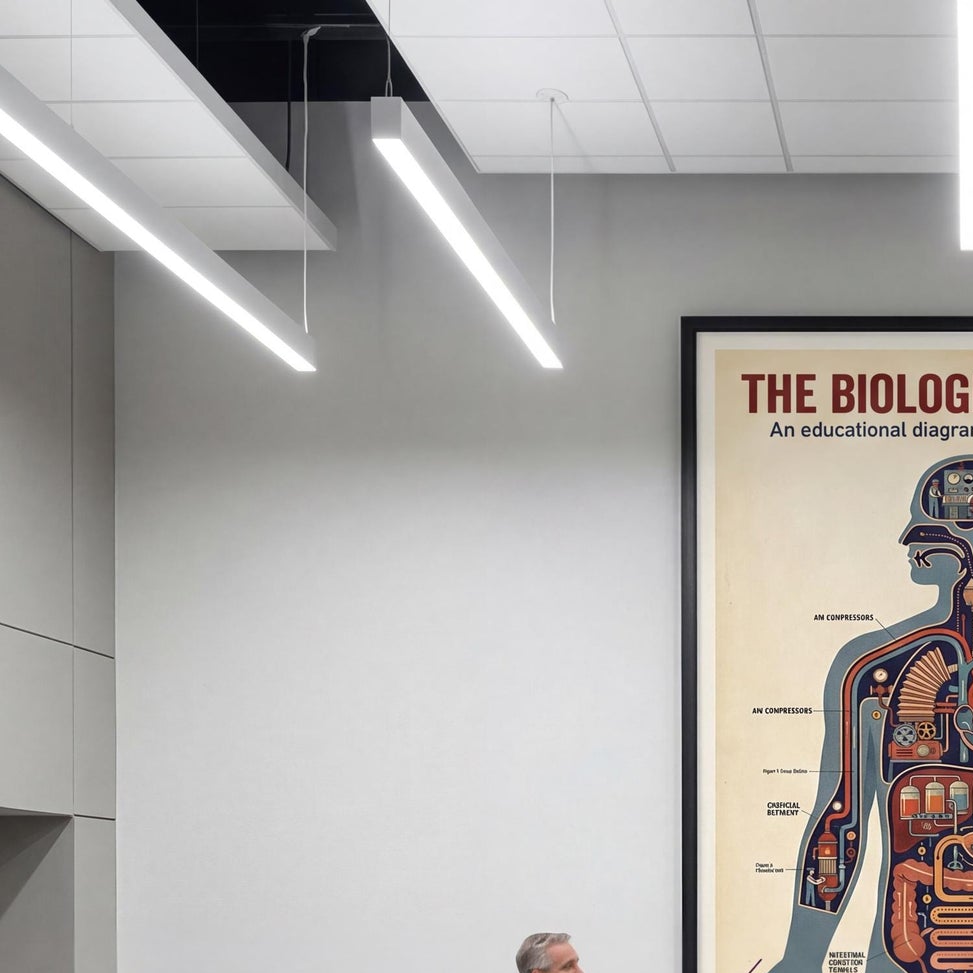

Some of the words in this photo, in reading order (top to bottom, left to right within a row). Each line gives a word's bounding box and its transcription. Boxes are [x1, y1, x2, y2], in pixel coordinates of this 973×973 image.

[741, 373, 817, 414] THE
[770, 421, 795, 438] An
[801, 421, 907, 438] educational
